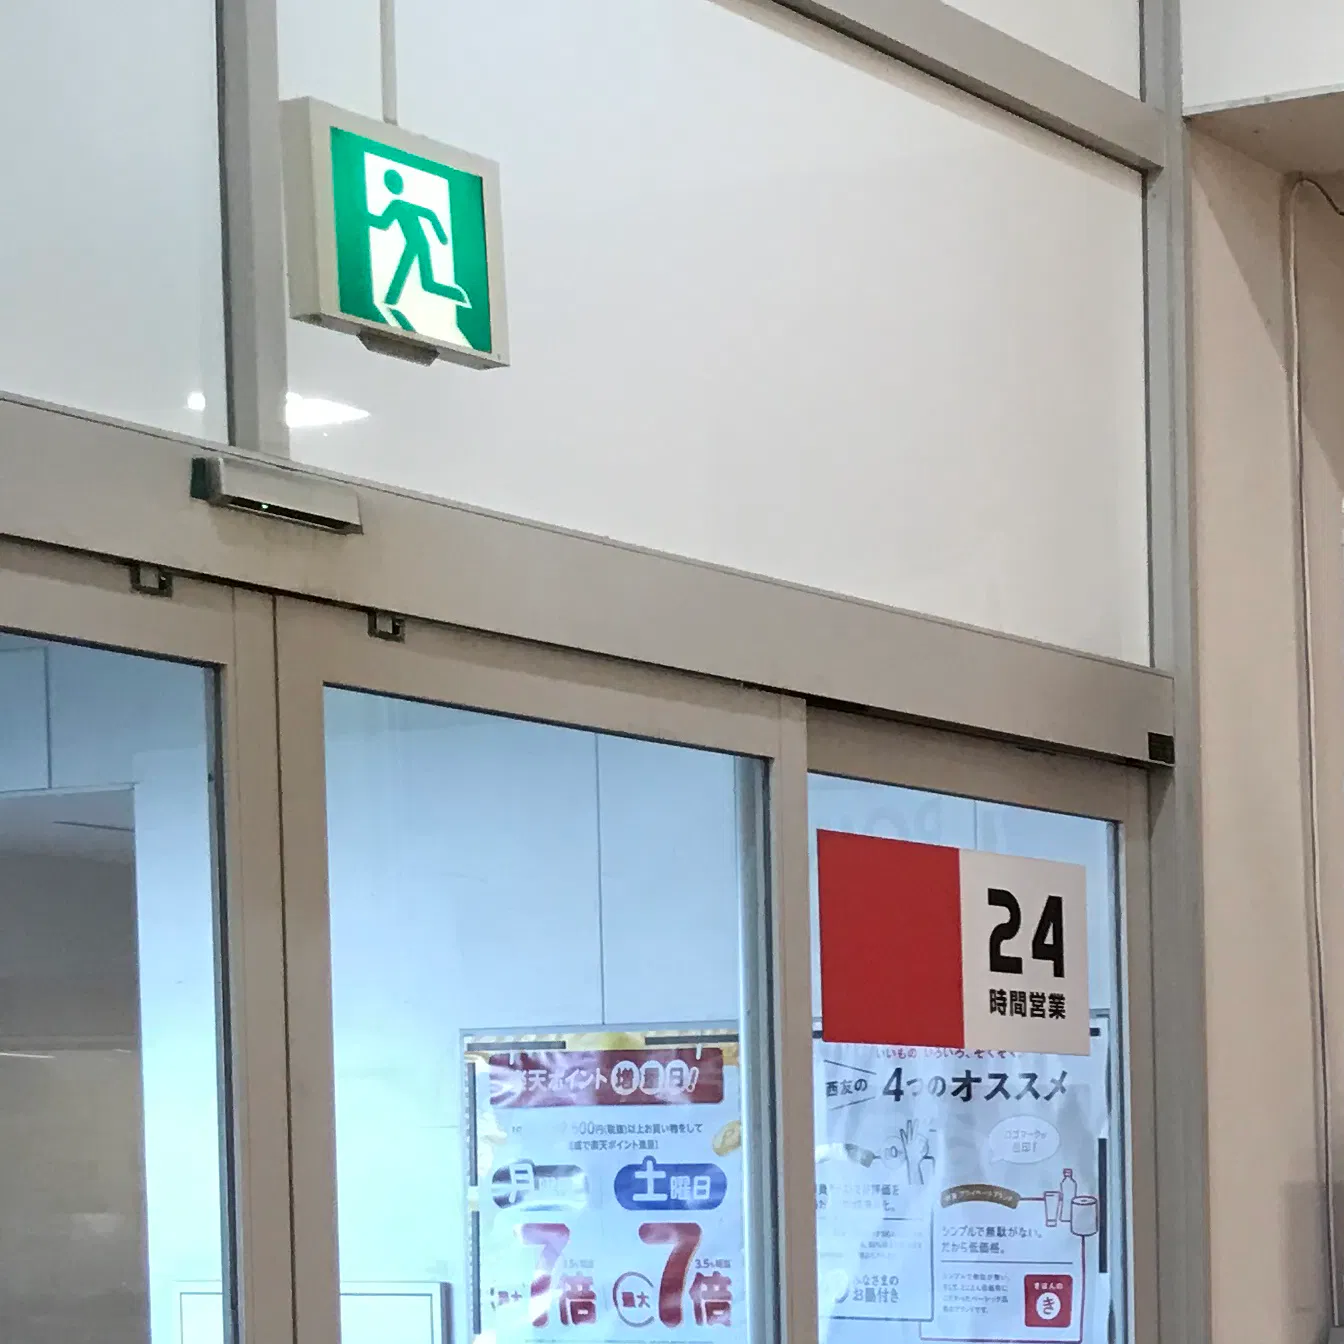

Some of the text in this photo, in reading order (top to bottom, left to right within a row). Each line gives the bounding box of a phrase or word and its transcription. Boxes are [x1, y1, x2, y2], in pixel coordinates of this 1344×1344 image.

[987, 887, 1065, 978] 24
[989, 988, 1066, 1019] 時間営業
[826, 1078, 867, 1097] 西友の
[882, 1066, 1068, 1102] 4つのオススメ
[633, 1158, 711, 1202] 土曜日
